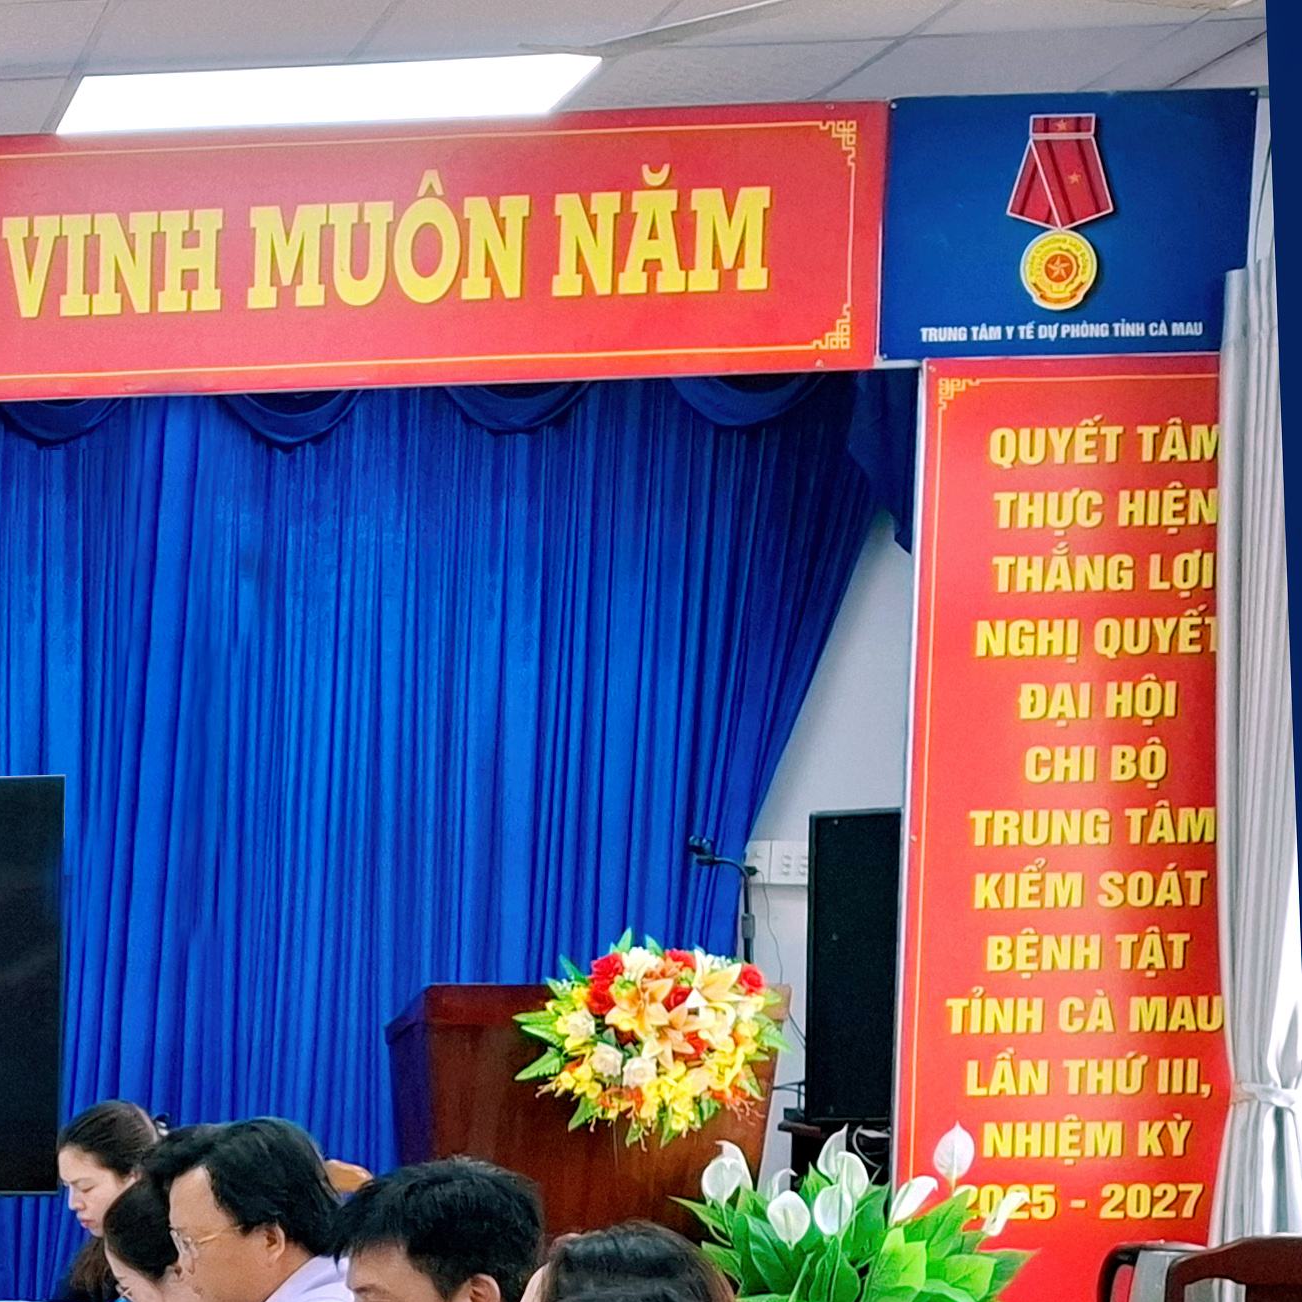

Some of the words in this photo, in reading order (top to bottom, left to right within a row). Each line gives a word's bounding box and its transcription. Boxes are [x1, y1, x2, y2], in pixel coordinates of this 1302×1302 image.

[2, 208, 223, 318] VINH
[247, 170, 529, 309] MUÔN
[552, 165, 770, 296] NĂM
[920, 326, 968, 342] TRUNG
[970, 323, 1002, 341] TÂM
[1005, 325, 1015, 340] Y
[1017, 323, 1035, 340] TẾ
[1038, 323, 1059, 341] DỰ
[1060, 323, 1110, 338] PHÒNG
[1112, 322, 1145, 337] TỈNH
[1149, 322, 1168, 336] CÀ
[1171, 322, 1203, 336] MAU
[989, 415, 1123, 469] QUYẾT
[1138, 416, 1219, 462] TÂM
[993, 488, 1102, 536] THỰC
[1118, 483, 1217, 533] HIỆN
[992, 542, 1133, 592] THẮNG
[1150, 550, 1212, 596] LỢI
[975, 619, 1078, 663] NGHỊ
[1017, 682, 1090, 727] ĐẠI
[1105, 675, 1175, 725] HỘI
[1024, 746, 1096, 783] CHI
[1110, 738, 1165, 788] BỘ
[969, 808, 1109, 848] TRUNG
[1125, 802, 1218, 844] TÂM
[974, 858, 1083, 908] KIỂM
[1095, 864, 1206, 907] SOÁT
[986, 929, 1101, 978] BỆNH
[1115, 927, 1189, 976] TẬT
[946, 986, 1043, 1034] TỈNH
[1058, 989, 1114, 1034] CÀ
[1129, 992, 1225, 1031] MAU
[966, 1048, 1049, 1095] LẦN
[1061, 1052, 1147, 1095] THỨ
[1158, 1060, 1210, 1096] III,
[983, 1114, 1122, 1165] NHIỆM
[1138, 1115, 1190, 1156] KỲ
[1071, 1200, 1085, 1208] -
[1100, 1184, 1202, 1218] 2027
